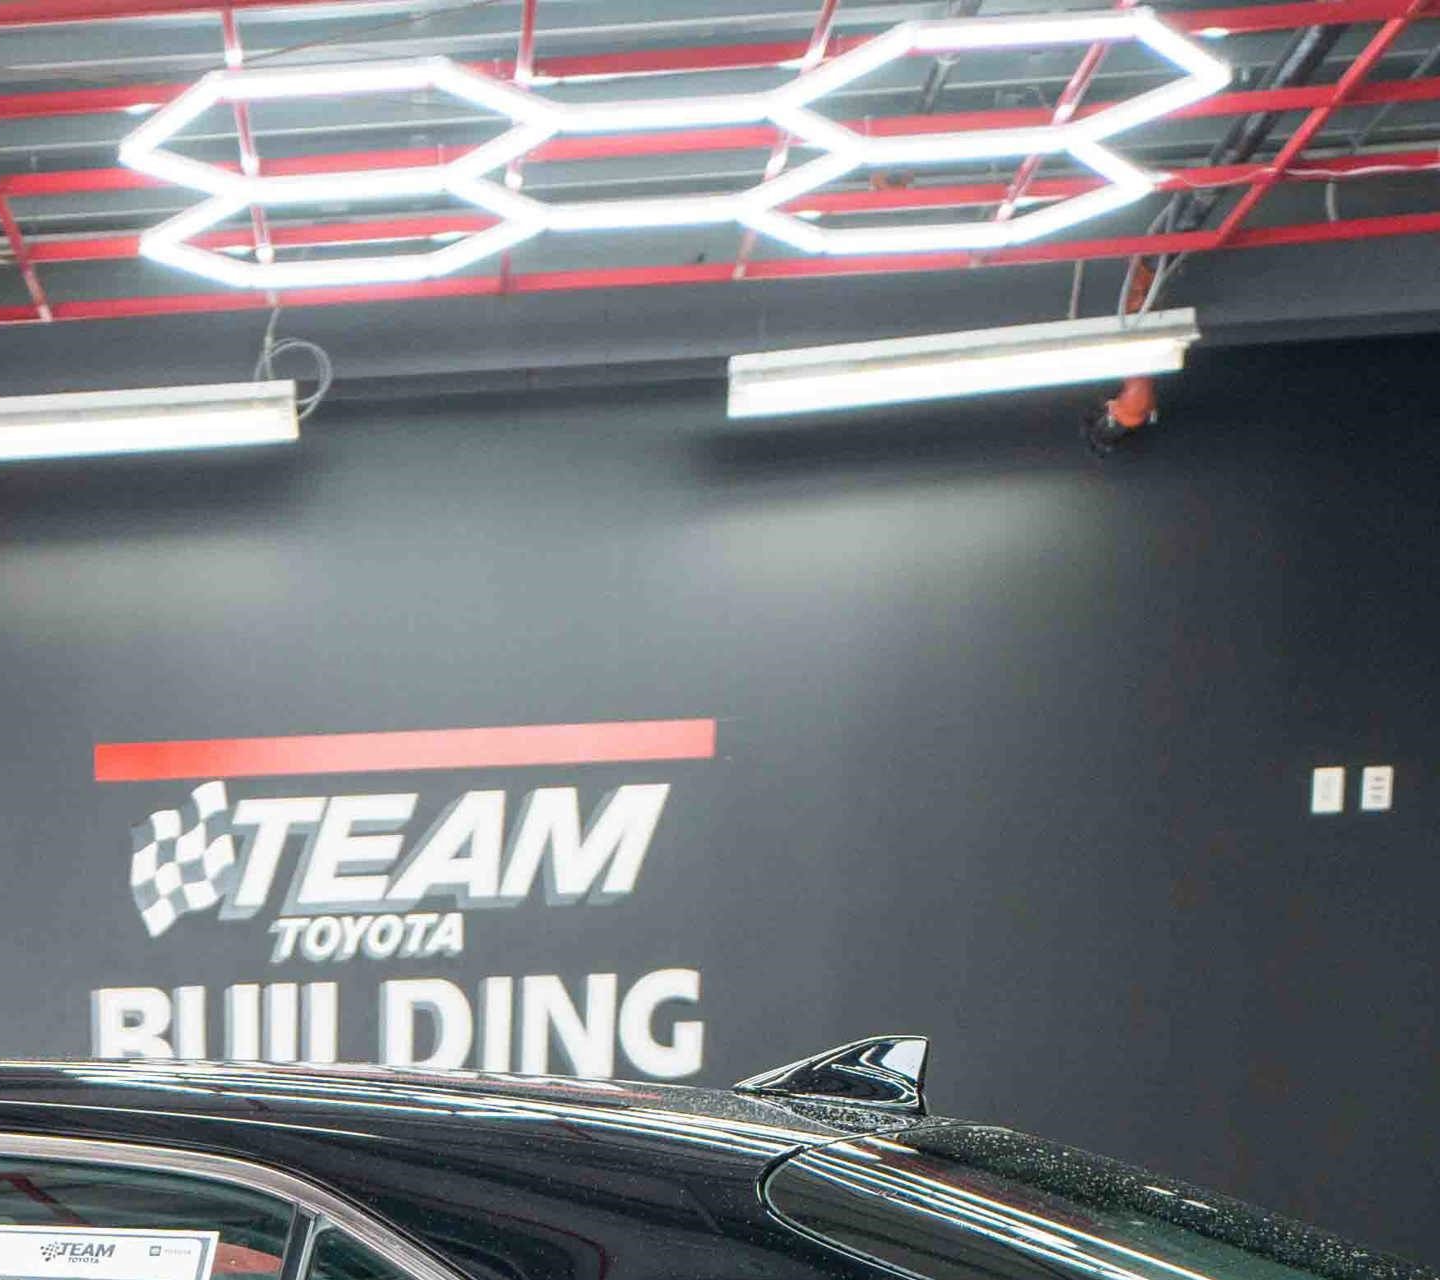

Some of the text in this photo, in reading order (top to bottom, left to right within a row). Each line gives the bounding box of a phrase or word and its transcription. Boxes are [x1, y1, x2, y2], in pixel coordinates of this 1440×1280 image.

[220, 782, 671, 920] TEAM
[269, 912, 464, 963] TOYOTA
[58, 1241, 116, 1258] TEAM
[68, 1256, 100, 1265] TOYOTA
